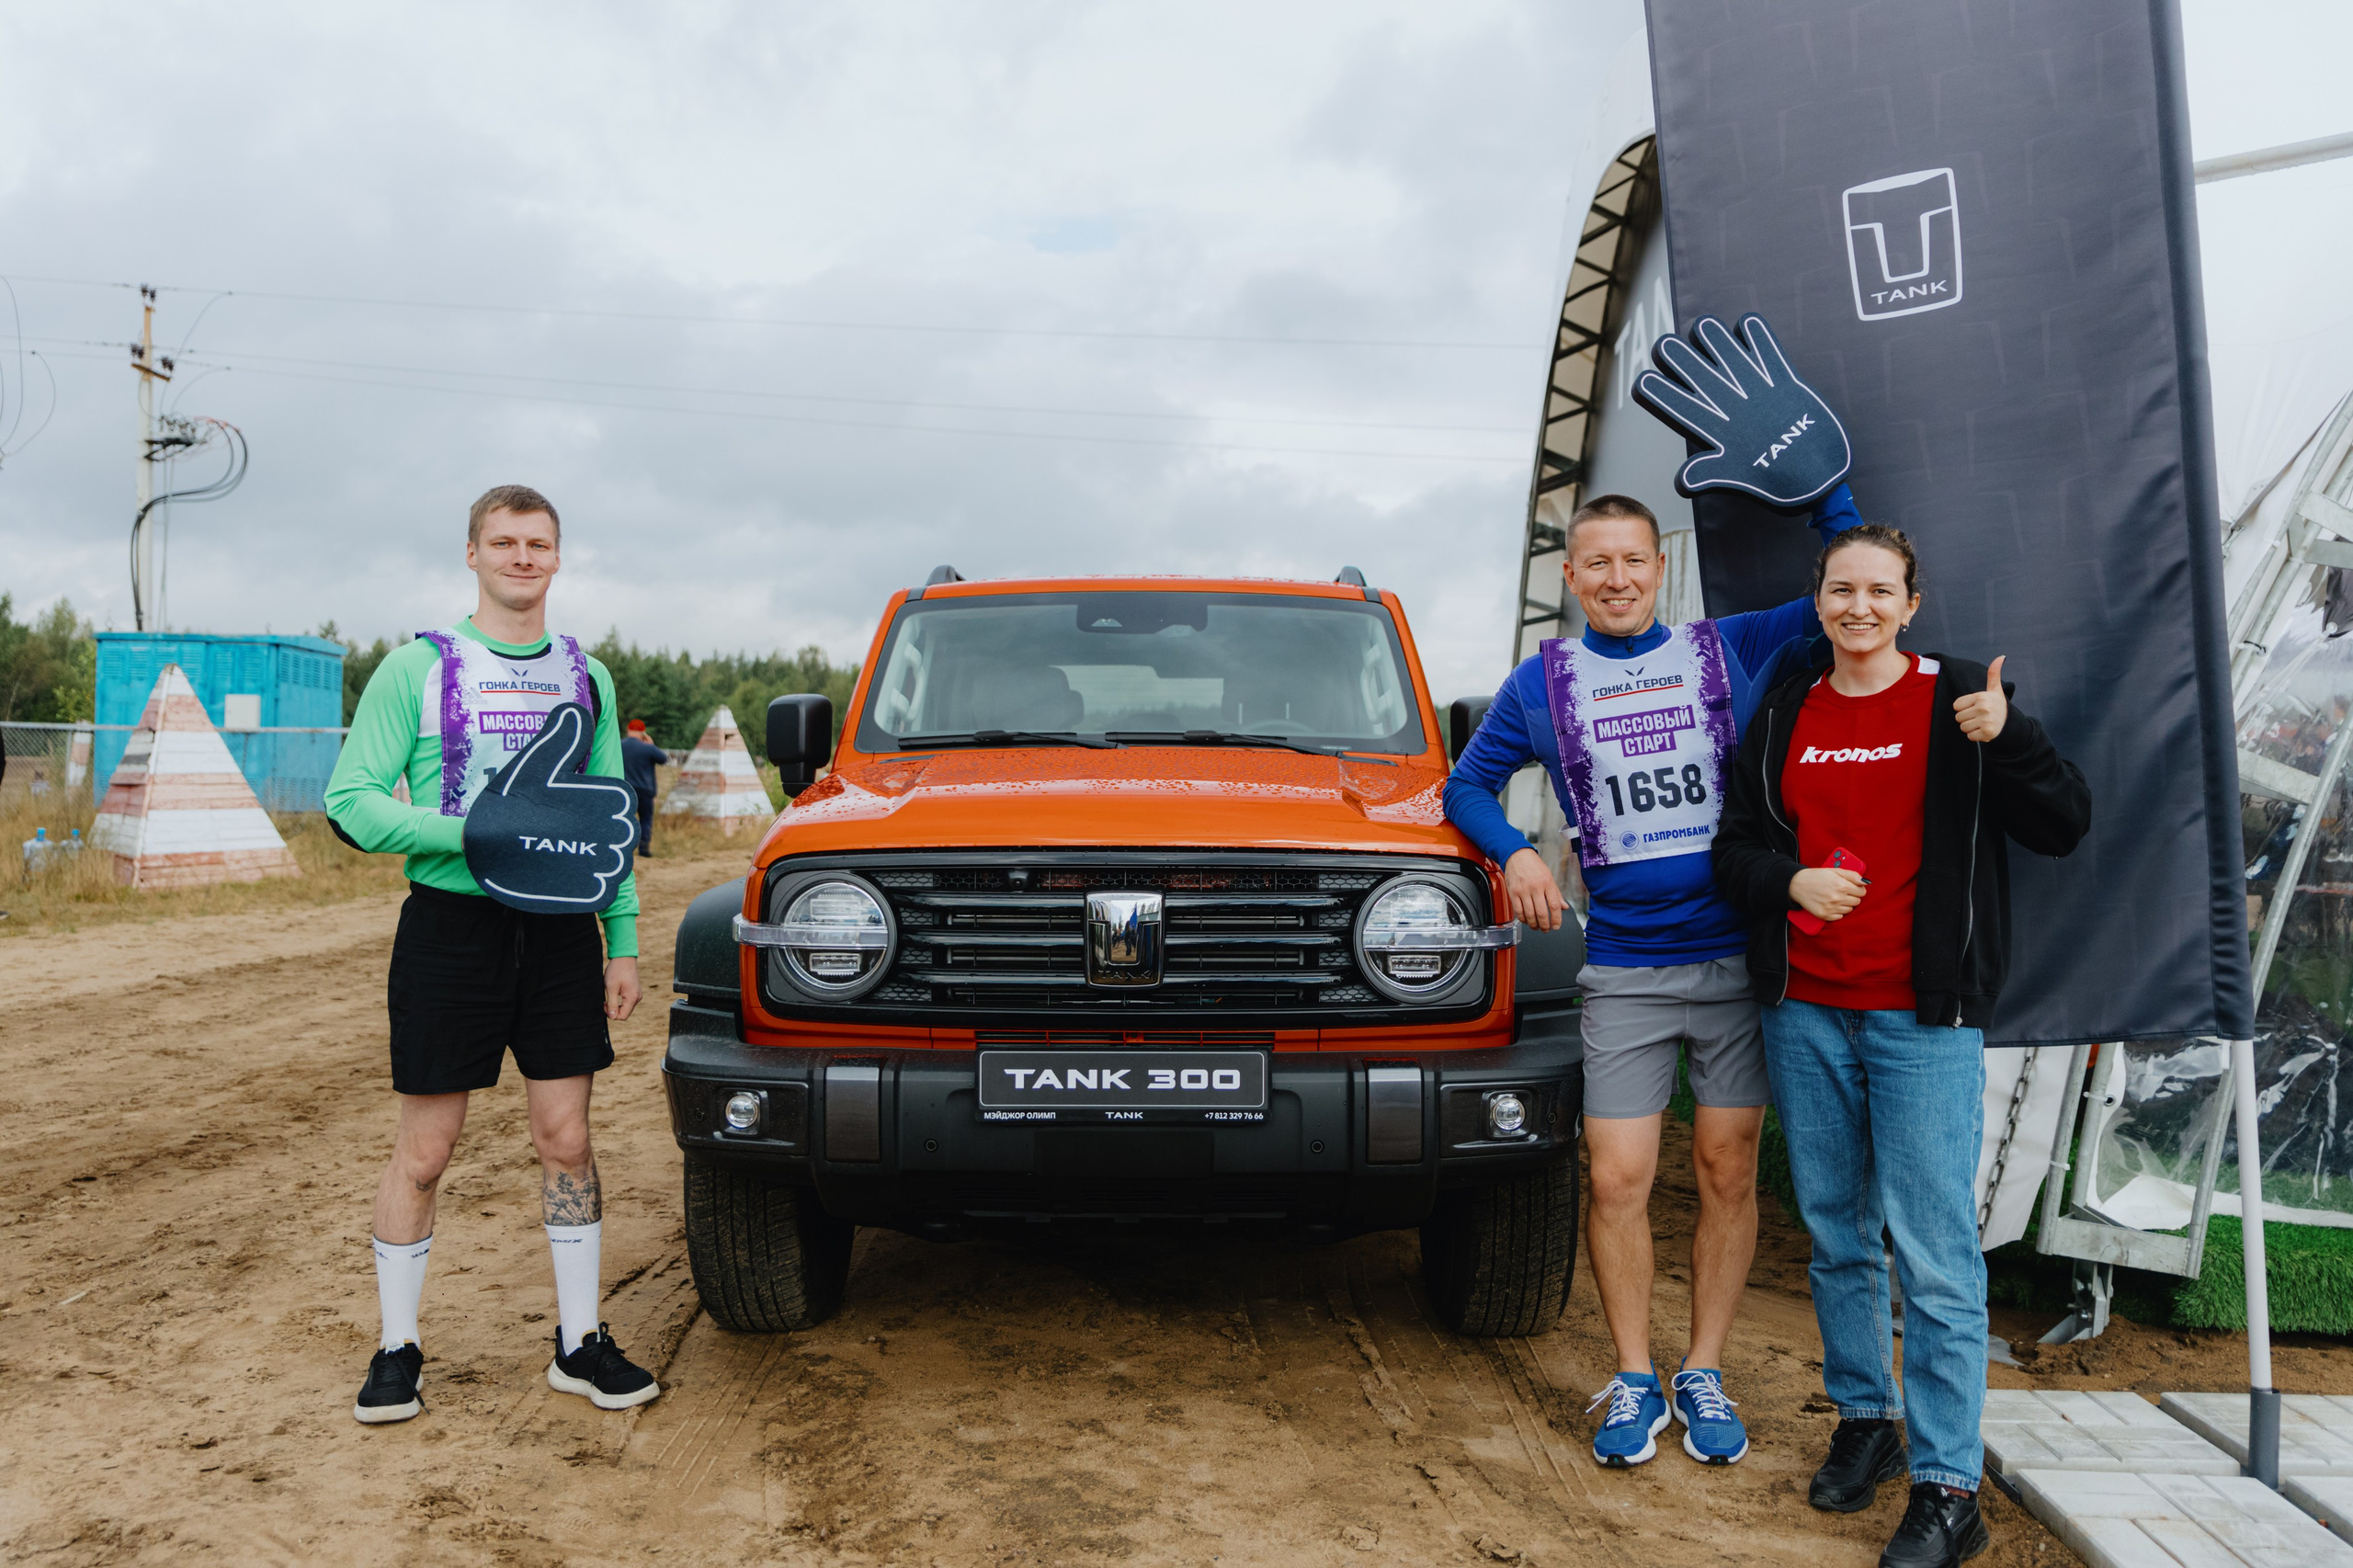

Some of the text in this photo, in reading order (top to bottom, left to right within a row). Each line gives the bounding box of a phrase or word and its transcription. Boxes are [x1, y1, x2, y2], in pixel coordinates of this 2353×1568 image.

[1870, 279, 1948, 305] TANK
[1752, 413, 1815, 468] TANK
[479, 681, 561, 692] ГОНКА ГЕРОЕВ
[1593, 675, 1683, 698] ГОНКА ГЕРОЕВ
[482, 714, 549, 731] МАССОВ
[1597, 705, 1691, 739] МАССОВЫЙ
[1623, 732, 1671, 755] СТАРТ
[1799, 743, 1903, 764] kronos
[1605, 764, 1707, 816] 1658
[1643, 824, 1711, 844] ГАЗПРОМБАНК
[518, 835, 597, 856] TANK
[1098, 970, 1152, 979] TANK
[1004, 1069, 1241, 1090] TANK 300
[984, 1110, 1025, 1119] МЭЙДЖОР
